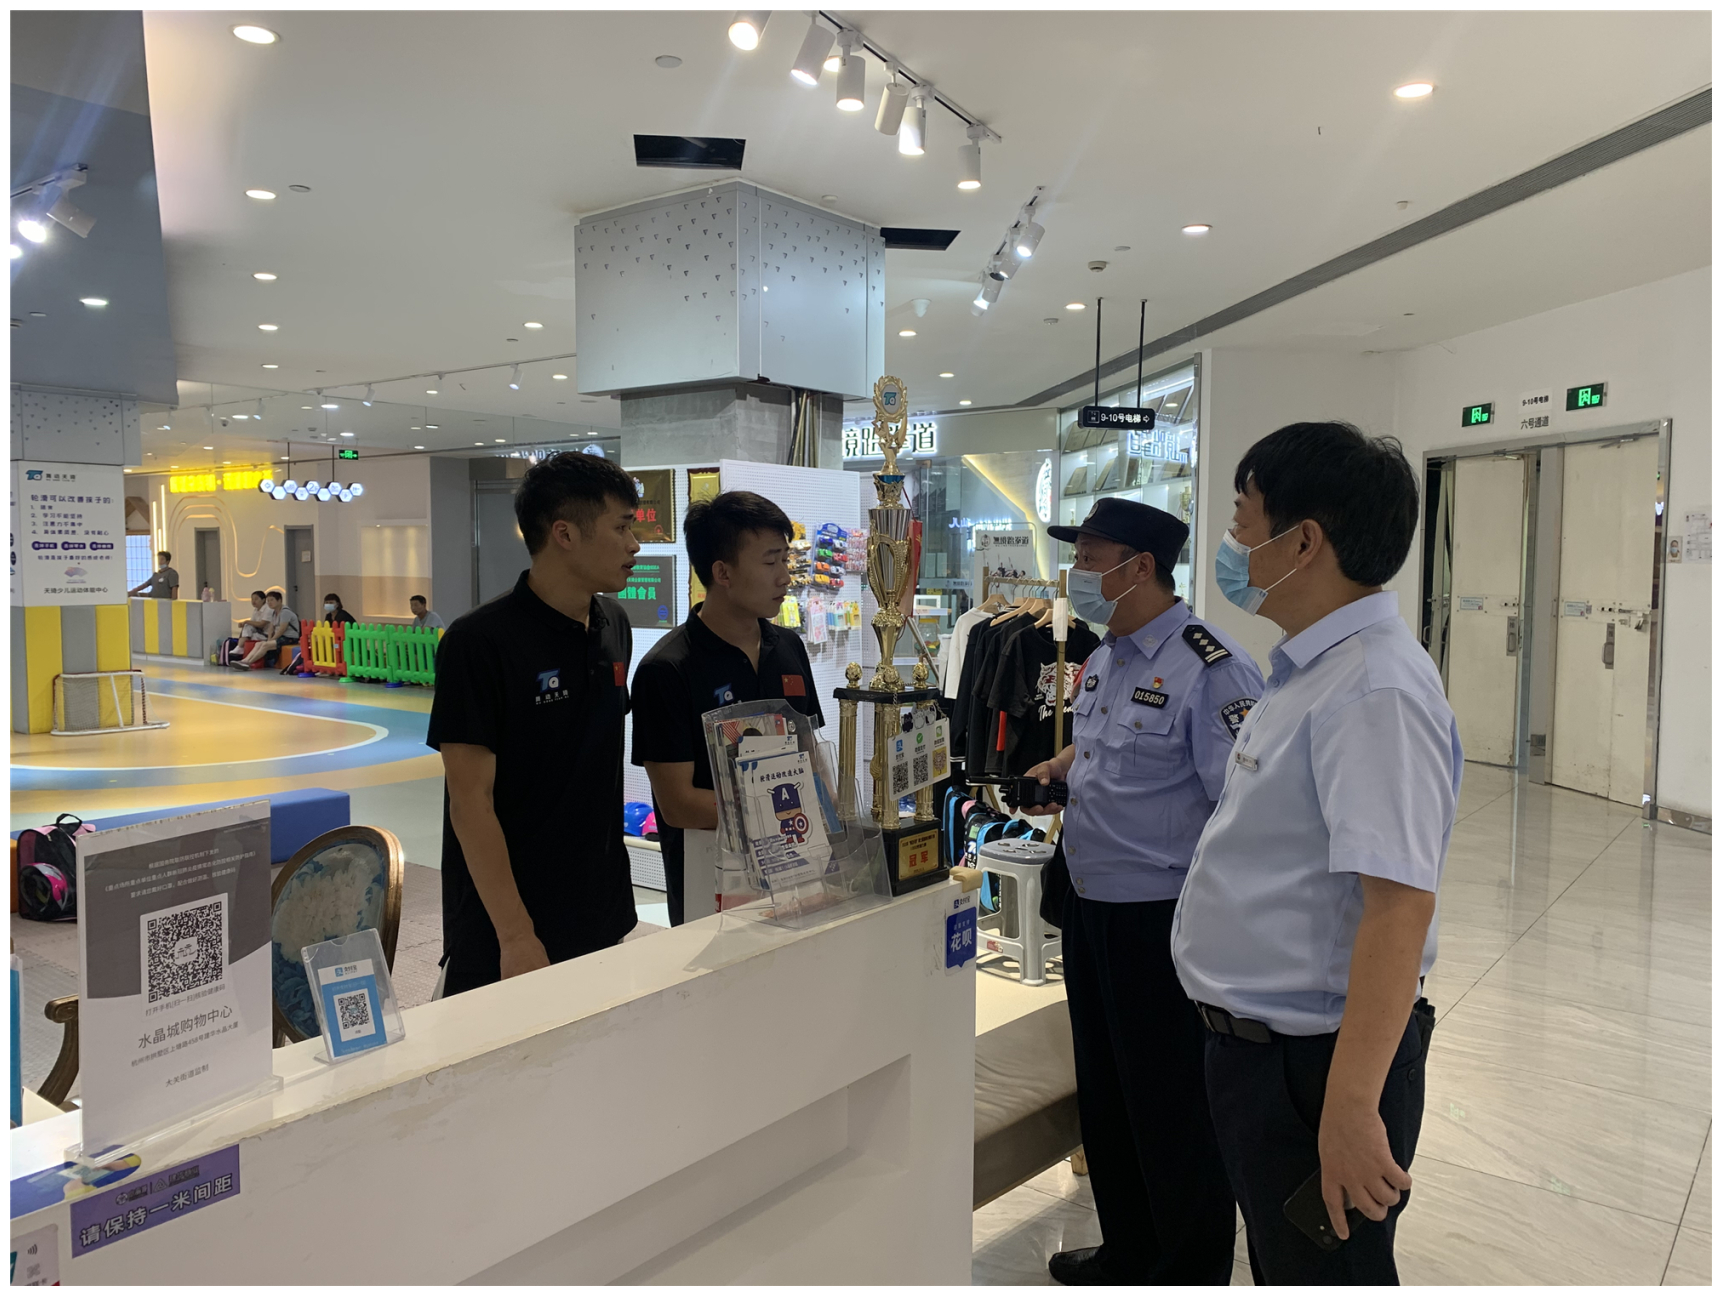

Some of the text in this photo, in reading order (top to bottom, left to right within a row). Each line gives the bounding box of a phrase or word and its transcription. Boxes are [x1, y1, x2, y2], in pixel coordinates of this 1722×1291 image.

[1100, 413, 1141, 424] 9-10号电梯
[1520, 415, 1550, 430] 六号通道
[1134, 691, 1165, 705] 015850
[1038, 704, 1054, 721] The
[760, 767, 805, 782] 轮滑运动改造大脑
[781, 787, 790, 801] A
[909, 850, 929, 868] 冠军
[951, 928, 972, 952] 花呗
[138, 1005, 233, 1049] 水晶城购物中心
[165, 1063, 209, 1088] 大关街道监制
[79, 1173, 233, 1248] 请保持一米间距
